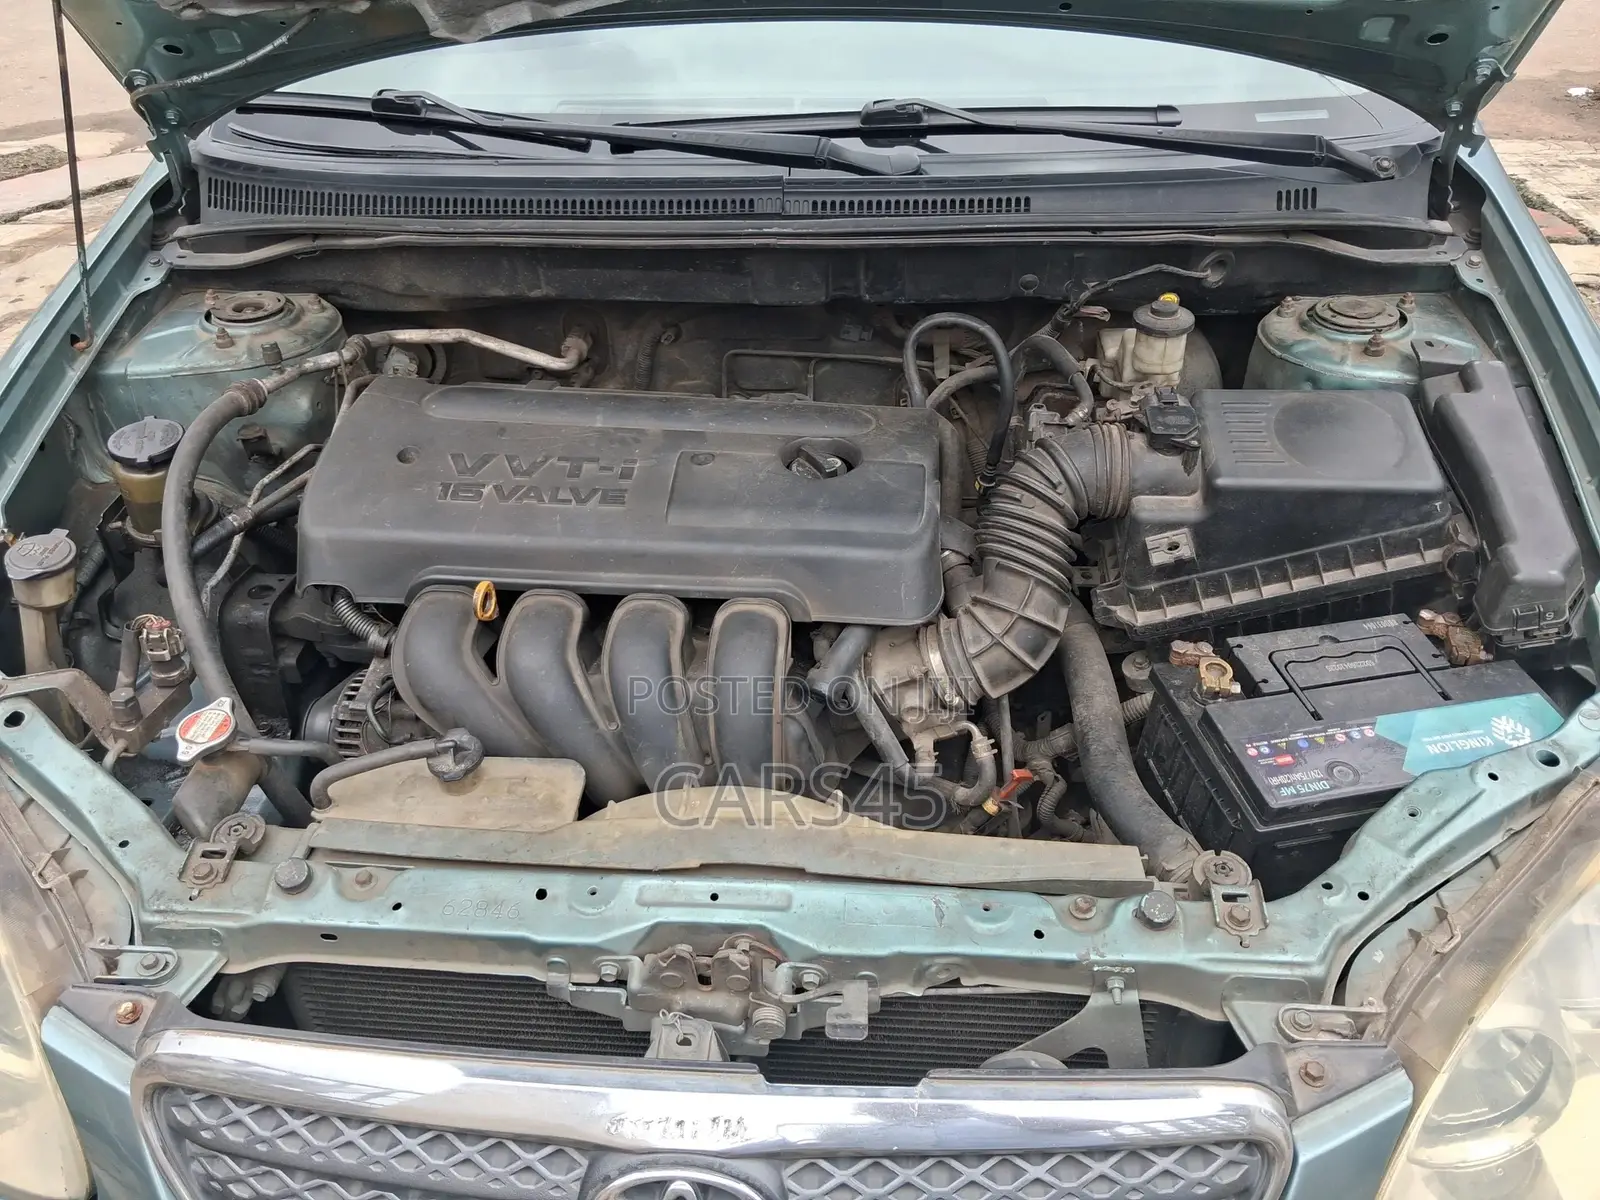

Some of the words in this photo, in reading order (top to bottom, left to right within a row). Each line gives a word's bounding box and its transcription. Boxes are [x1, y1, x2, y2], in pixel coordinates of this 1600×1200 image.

[449, 452, 638, 482] VVT-i
[1426, 736, 1494, 754] KINGLION
[1280, 786, 1297, 796] MF
[1297, 781, 1330, 794] DIN75
[441, 899, 521, 919] 62846
